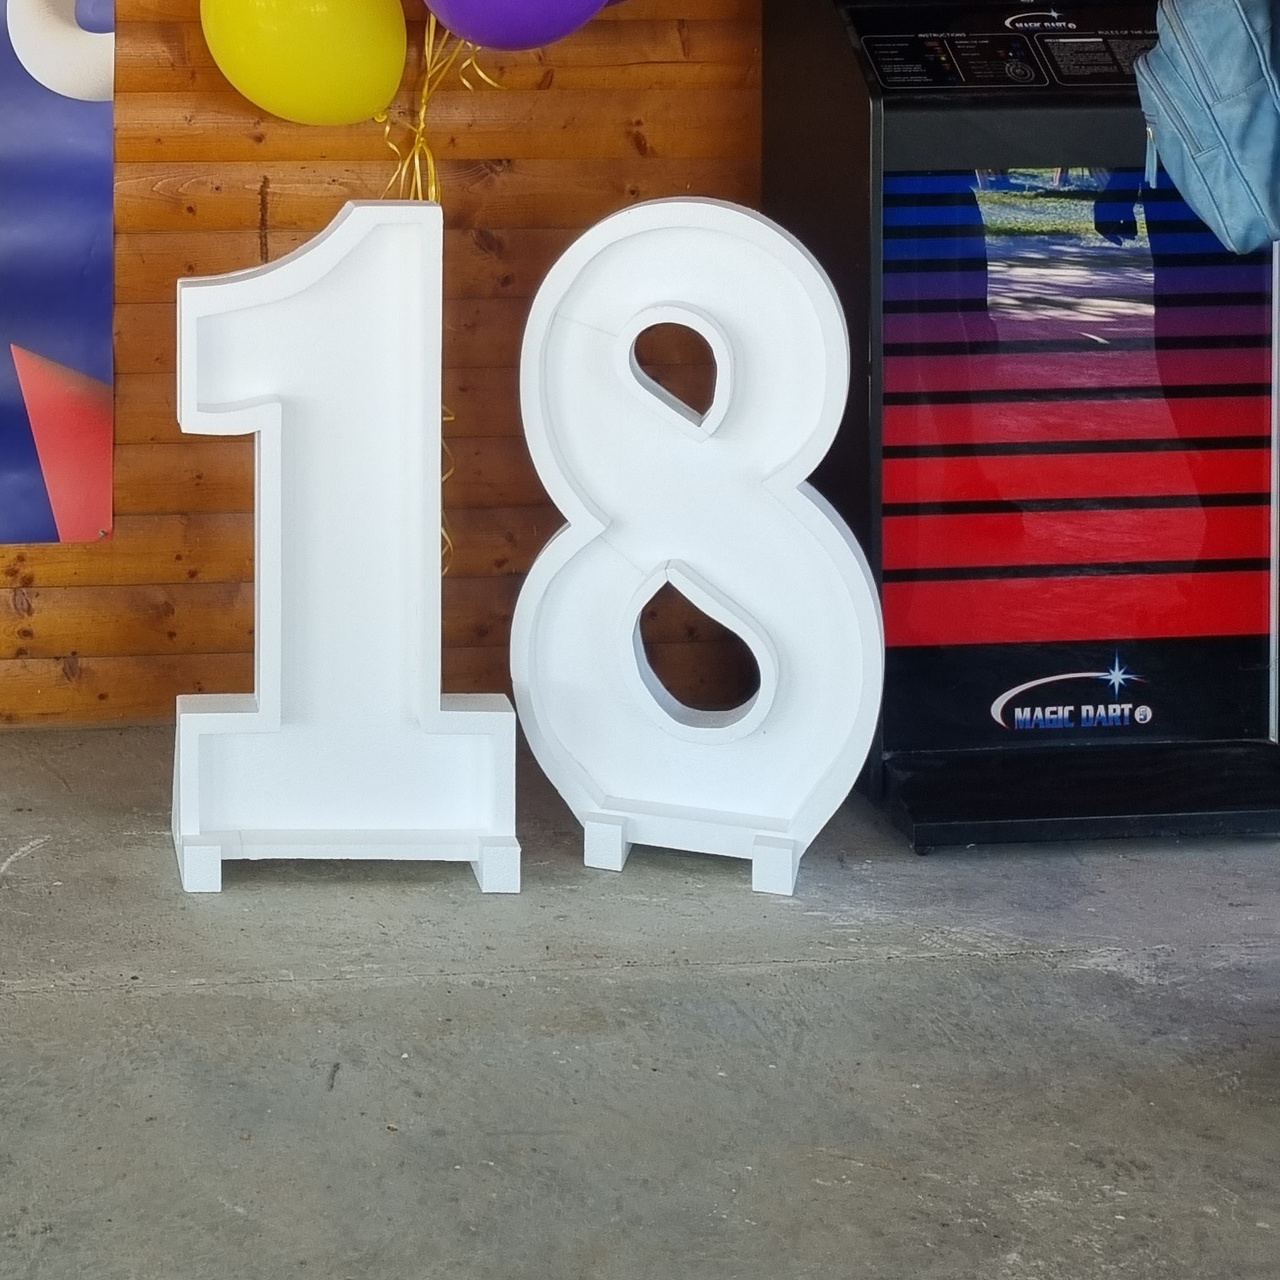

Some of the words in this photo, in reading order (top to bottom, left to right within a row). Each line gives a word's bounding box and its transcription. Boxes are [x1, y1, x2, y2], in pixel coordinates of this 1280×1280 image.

[173, 196, 885, 895] 18
[1014, 705, 1075, 730] MAGIC
[1081, 704, 1133, 727] DART
